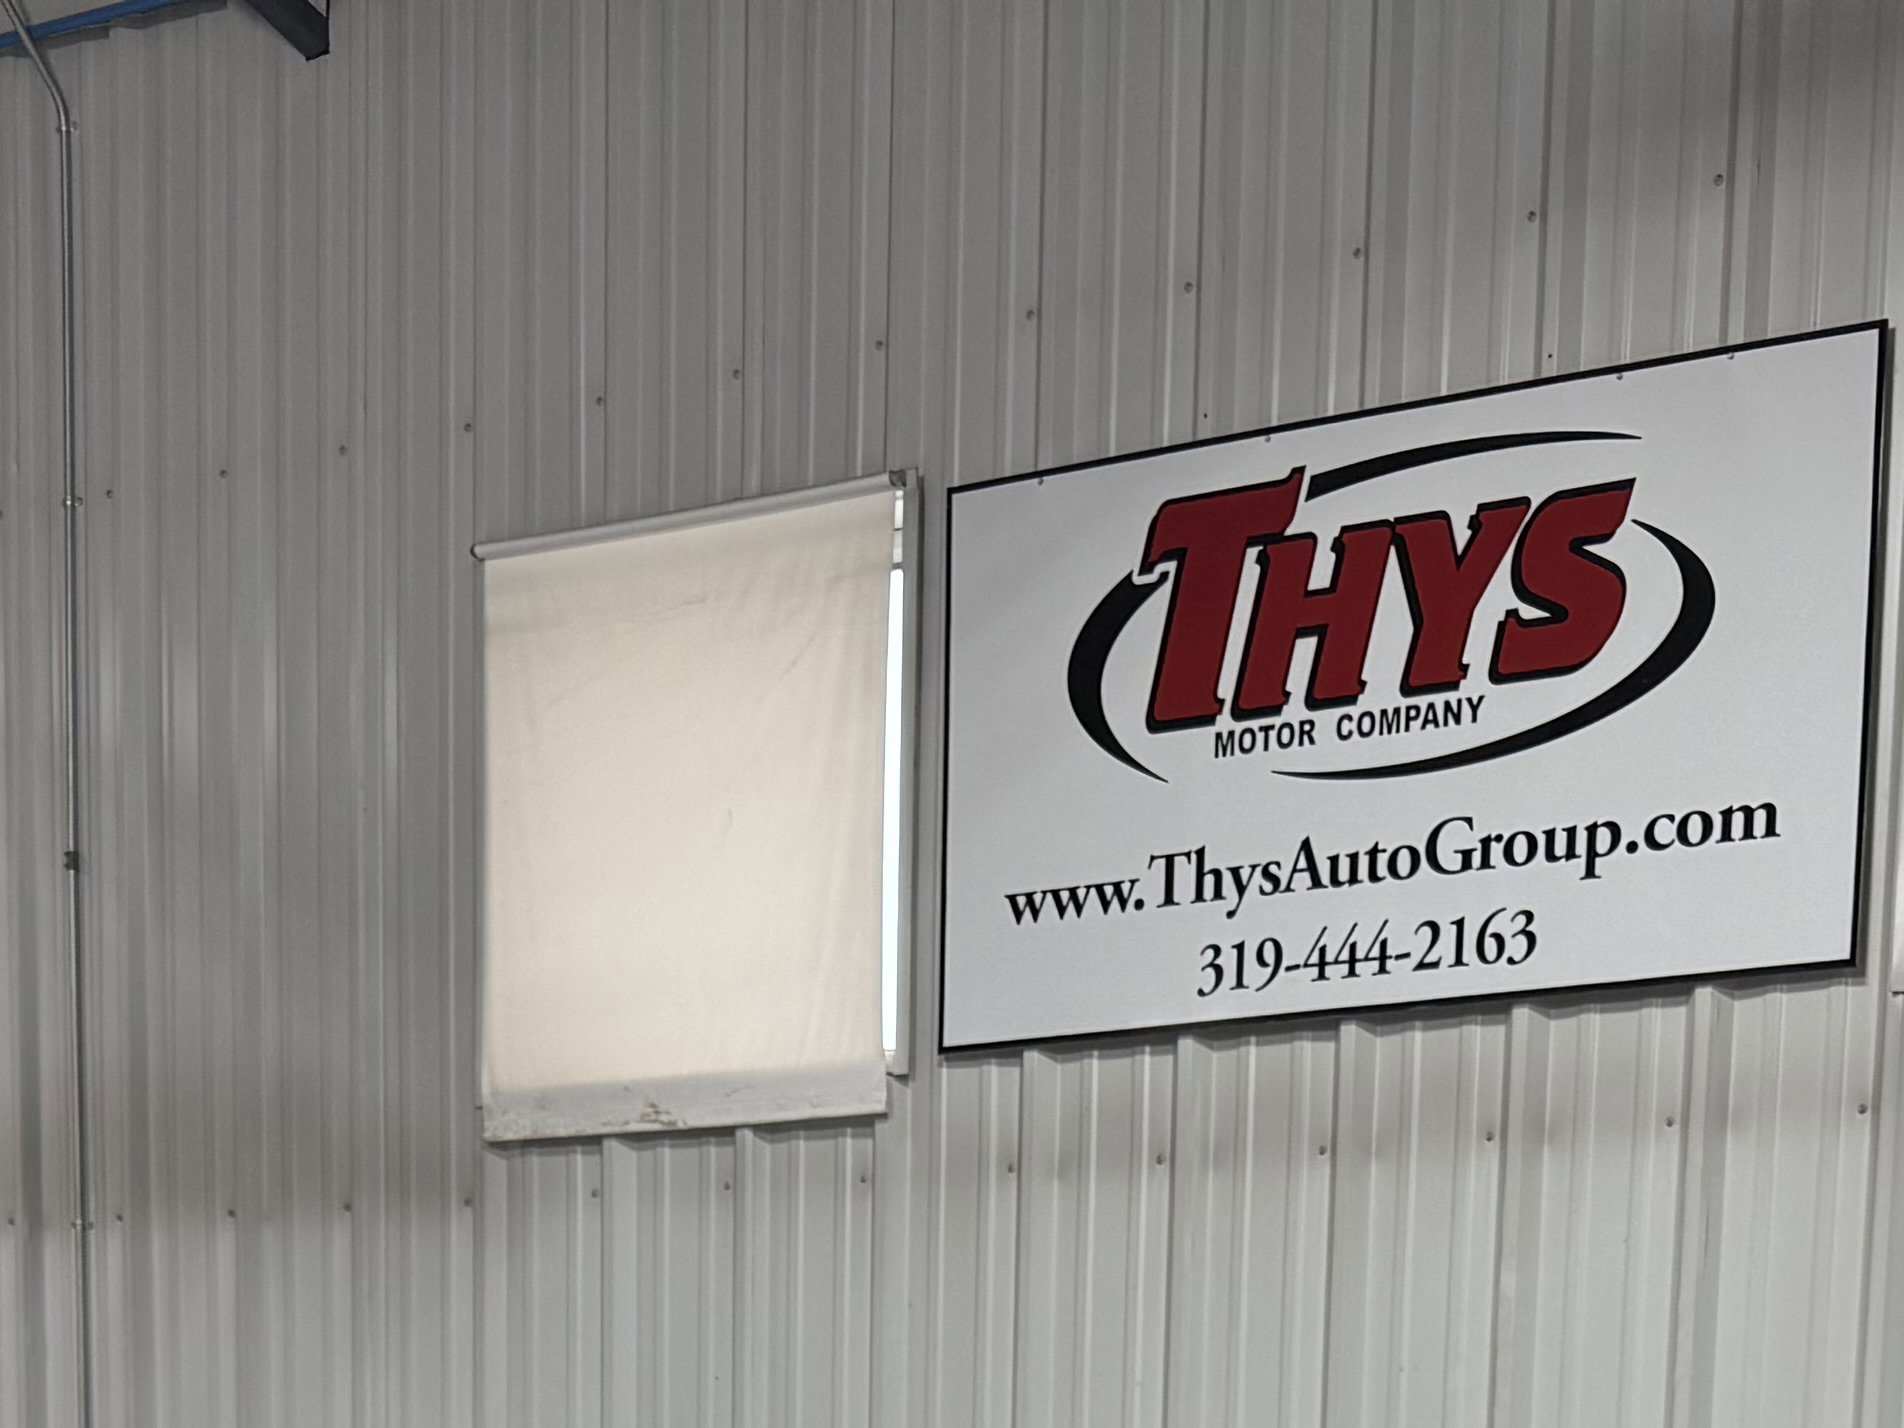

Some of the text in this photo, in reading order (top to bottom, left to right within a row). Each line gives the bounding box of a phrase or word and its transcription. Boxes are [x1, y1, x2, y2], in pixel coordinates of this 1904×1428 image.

[1139, 465, 1636, 734] THYS
[1214, 695, 1486, 758] MOTOR COMPANY
[1005, 802, 1781, 925] www.ThysAutoGroup.com
[1197, 908, 1538, 997] 319-444-2163
